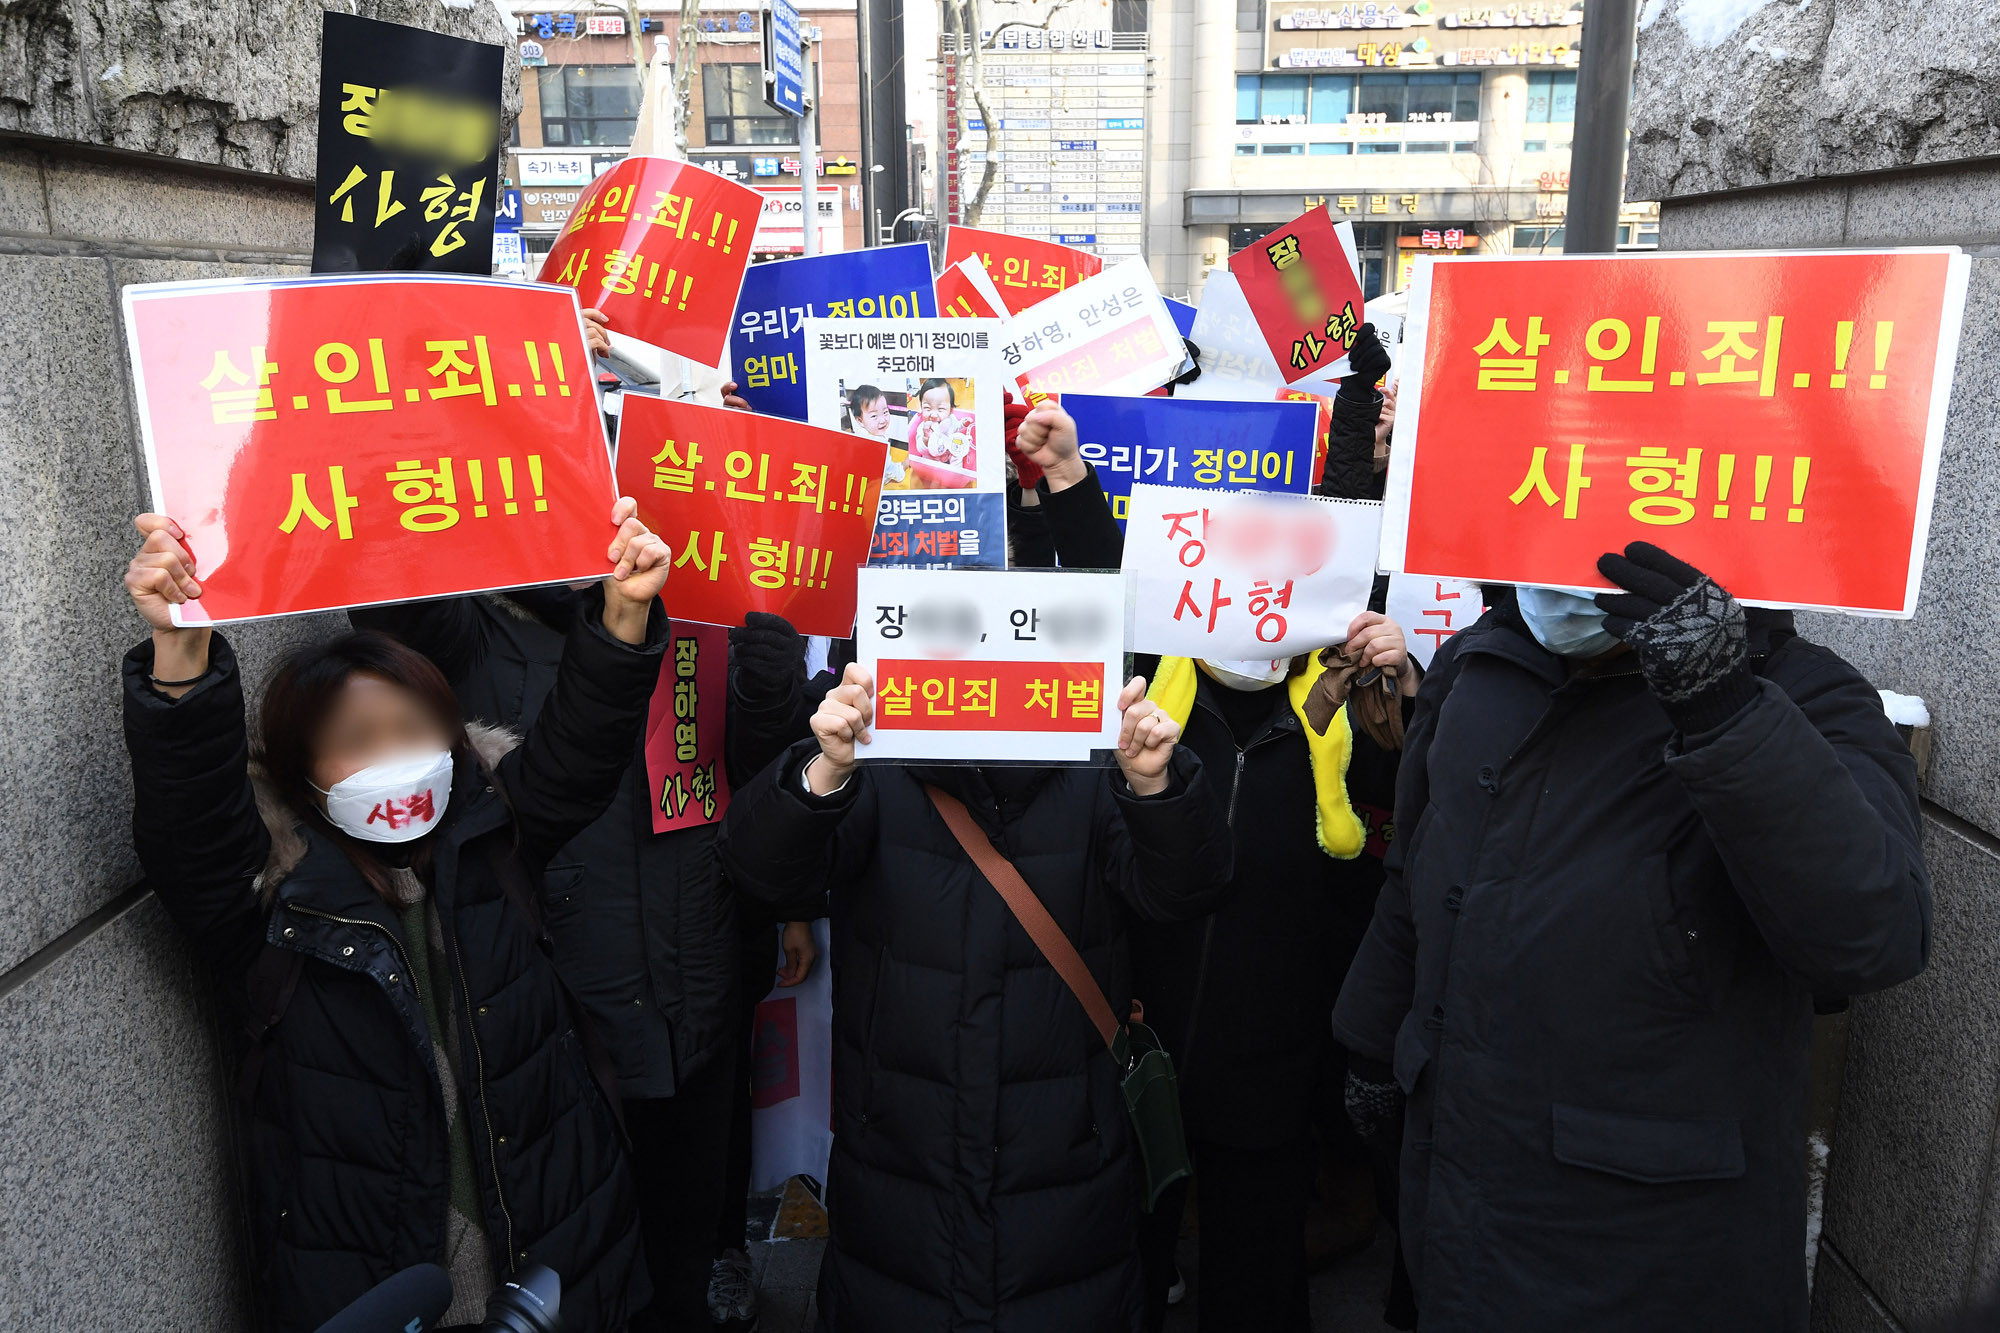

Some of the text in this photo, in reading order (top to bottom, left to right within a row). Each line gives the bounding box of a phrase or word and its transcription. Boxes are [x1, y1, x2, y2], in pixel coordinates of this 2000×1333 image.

[589, 19, 622, 33] 무료상담
[1294, 3, 1401, 27] 법무사 신용수
[522, 45, 540, 56] 303
[1291, 42, 1402, 66] 법무법인 대상
[1458, 47, 1500, 63] 법무사
[527, 161, 582, 174] 속기·녹취
[784, 202, 833, 212] COEE
[1304, 194, 1420, 214] 남부빌딩
[567, 184, 739, 255] 살.인.죄.!!
[1421, 229, 1464, 249] 녹취
[739, 303, 817, 343] 우리가
[1003, 286, 1143, 365] 장하영, 안성은
[819, 332, 989, 350] 꽃보다 예쁜 아기 정인이를
[1110, 325, 1164, 364] 처벌
[743, 352, 799, 388] 엄마
[877, 355, 935, 373] 추모하며
[1472, 315, 1894, 397] 살.인.죄.!!
[200, 335, 571, 425] 살.인.죄.!!
[651, 439, 869, 517] 살.인.죄.!!
[1078, 443, 1295, 485] 우리가 정인이
[878, 497, 966, 526] 양부모의
[914, 529, 980, 557] 처벌을
[674, 639, 698, 762] 장하영
[878, 676, 1101, 719] 살인죄 처벌
